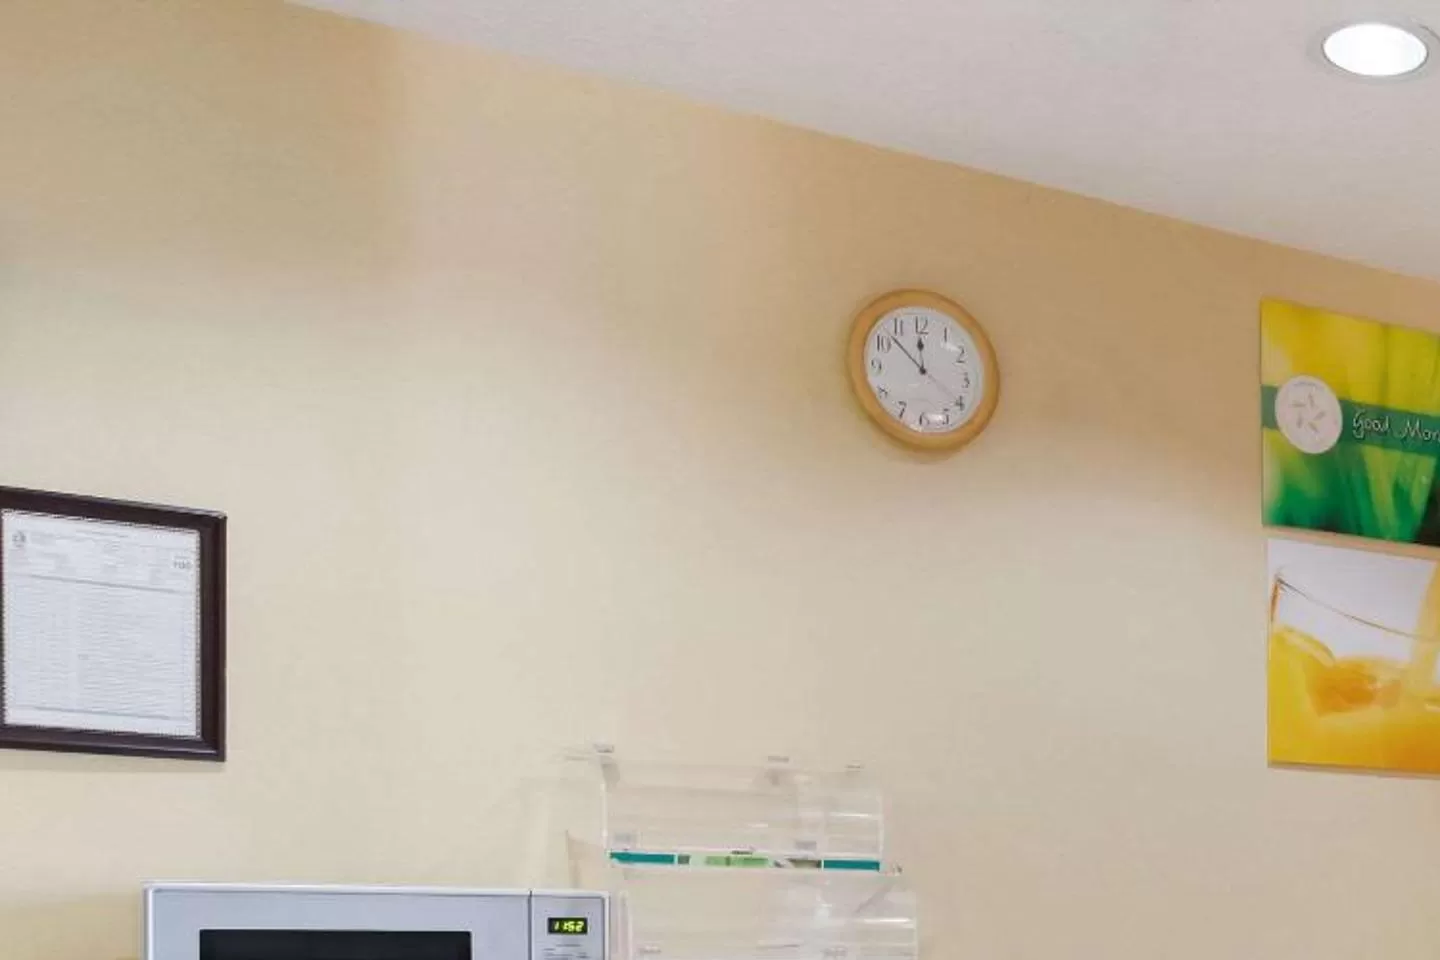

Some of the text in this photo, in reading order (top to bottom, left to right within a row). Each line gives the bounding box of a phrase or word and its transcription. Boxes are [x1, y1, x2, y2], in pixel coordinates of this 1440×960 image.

[893, 317, 905, 336] 11
[914, 316, 929, 335] 12
[876, 334, 891, 353] 10
[954, 345, 966, 364] 2
[871, 359, 882, 374] 9
[961, 371, 970, 389] 3
[898, 401, 907, 419] 7
[954, 396, 965, 411] 4
[919, 412, 930, 426] 6
[942, 408, 950, 425] 5
[1352, 406, 1389, 439] Good
